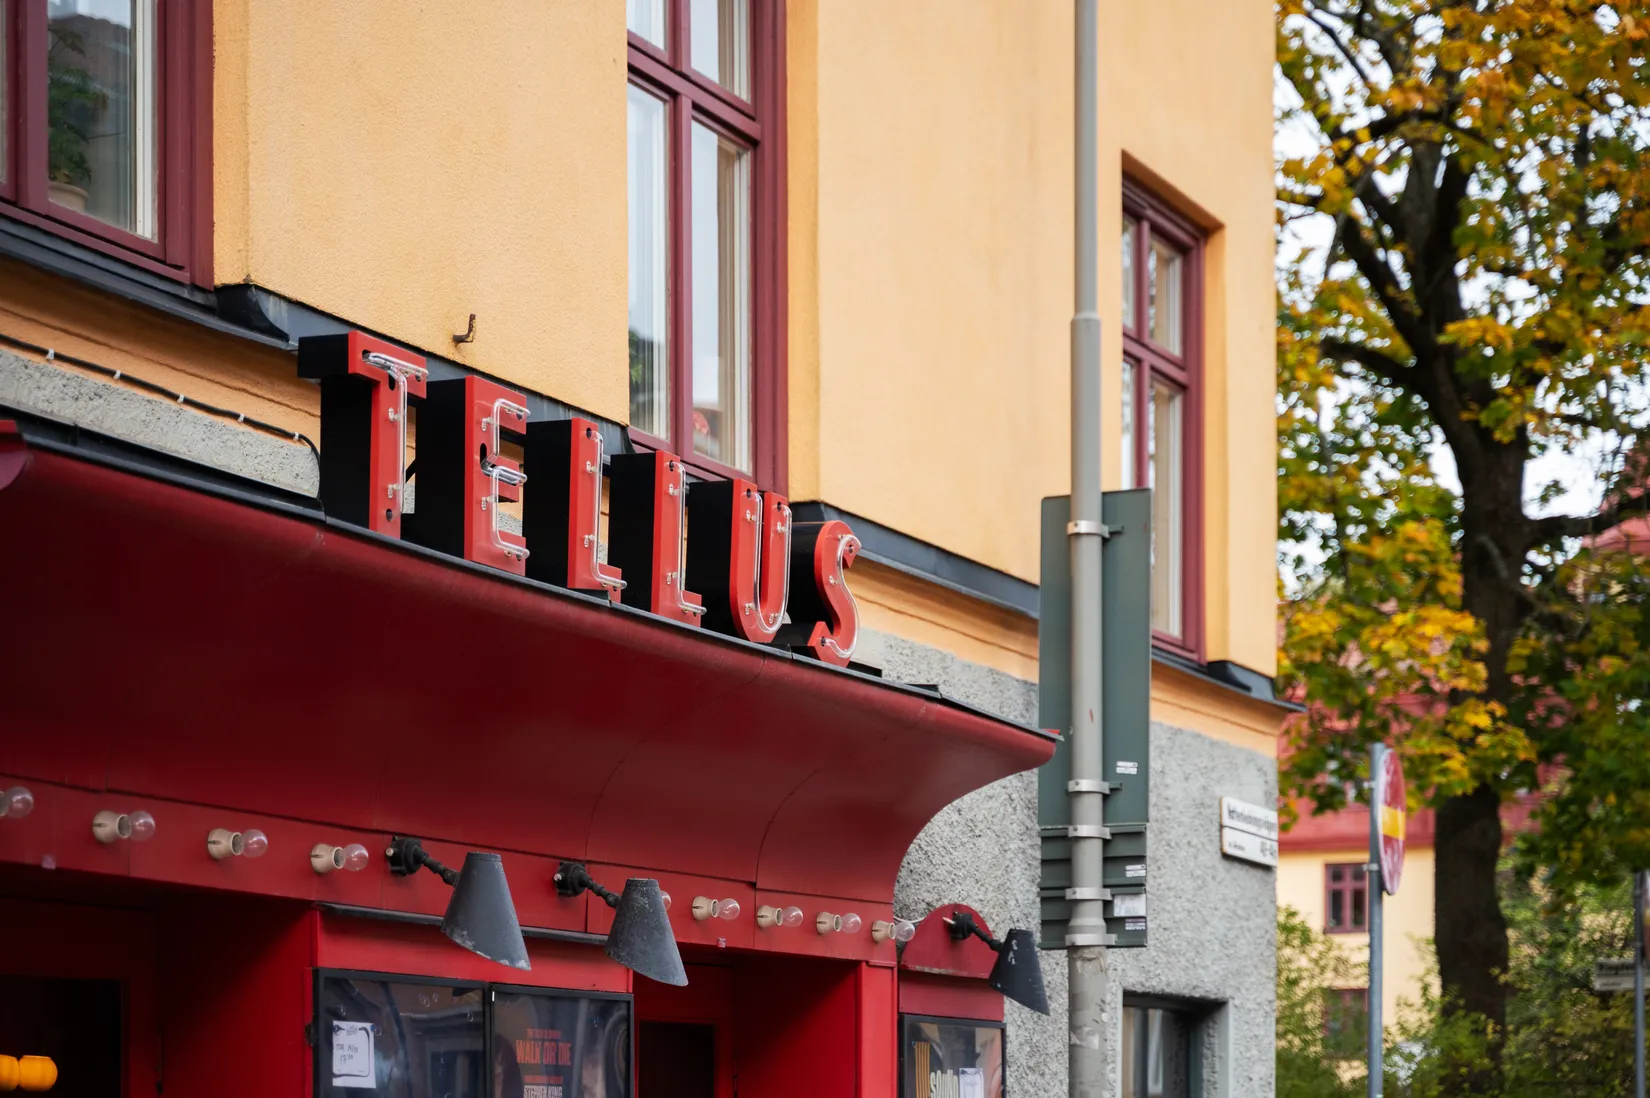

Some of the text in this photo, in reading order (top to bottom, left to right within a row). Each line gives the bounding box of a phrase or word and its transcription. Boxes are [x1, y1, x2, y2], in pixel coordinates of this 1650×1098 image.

[346, 330, 862, 668] TELLUS
[516, 1039, 572, 1066] WALK OR DIE
